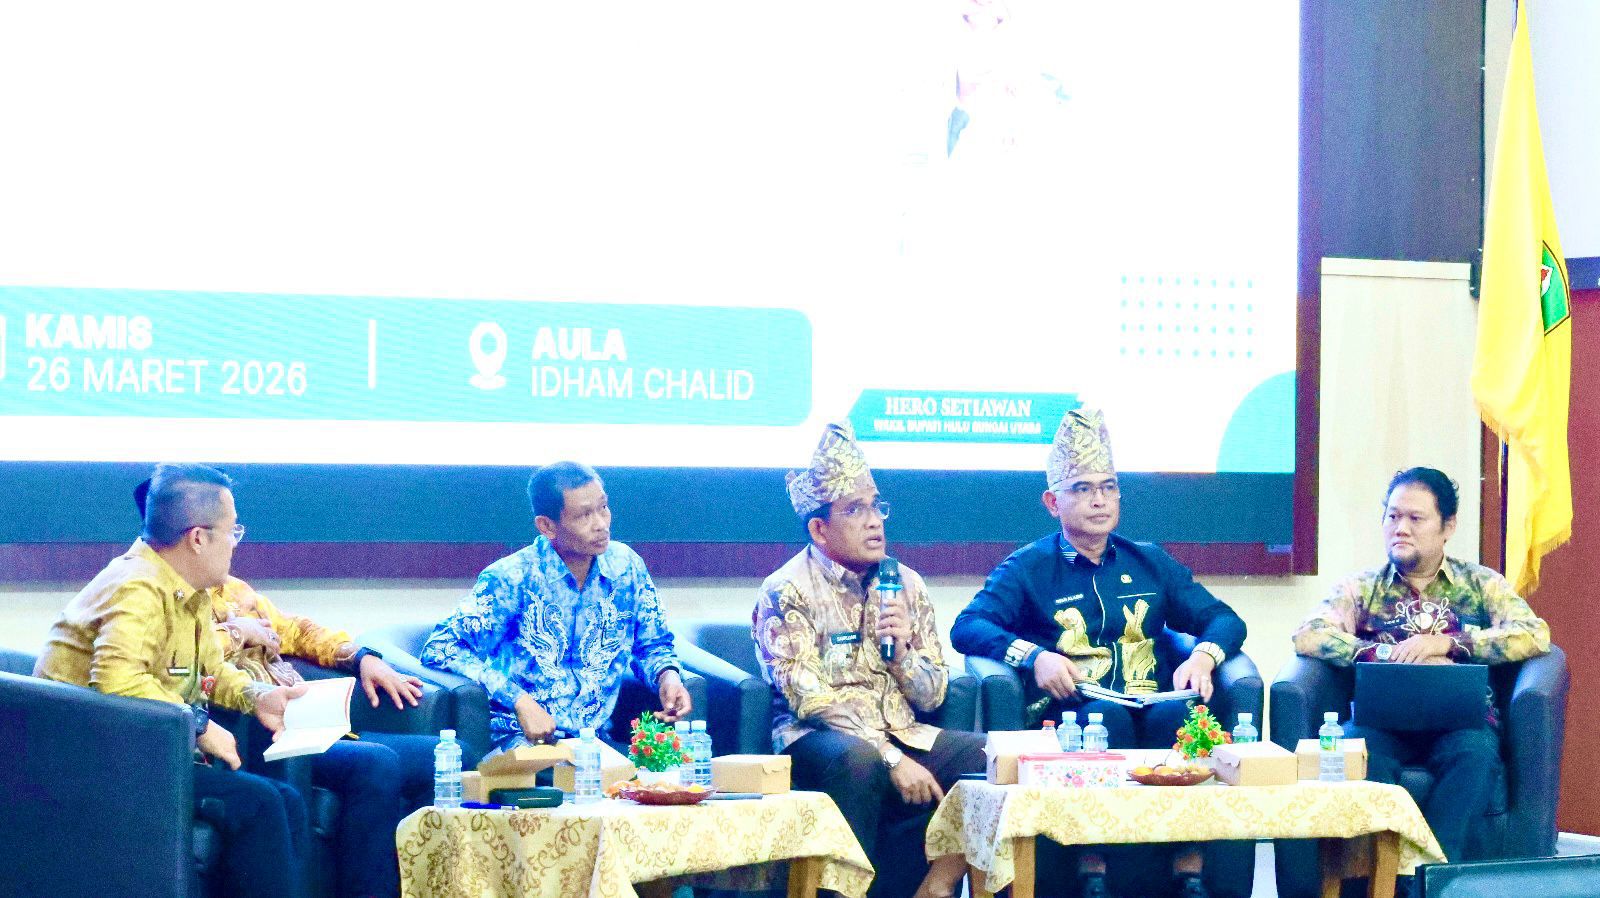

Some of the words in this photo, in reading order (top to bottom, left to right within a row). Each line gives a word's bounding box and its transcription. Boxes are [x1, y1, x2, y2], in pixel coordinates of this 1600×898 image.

[25, 313, 153, 350] KAMIS
[532, 327, 627, 361] AULA
[27, 357, 71, 392] 26
[83, 358, 208, 394] MARET
[221, 360, 308, 396] 2026
[531, 366, 632, 398] IDHAM
[643, 369, 754, 401] CHALID
[885, 396, 937, 416] HERO
[940, 397, 1032, 418] SETIAWAN
